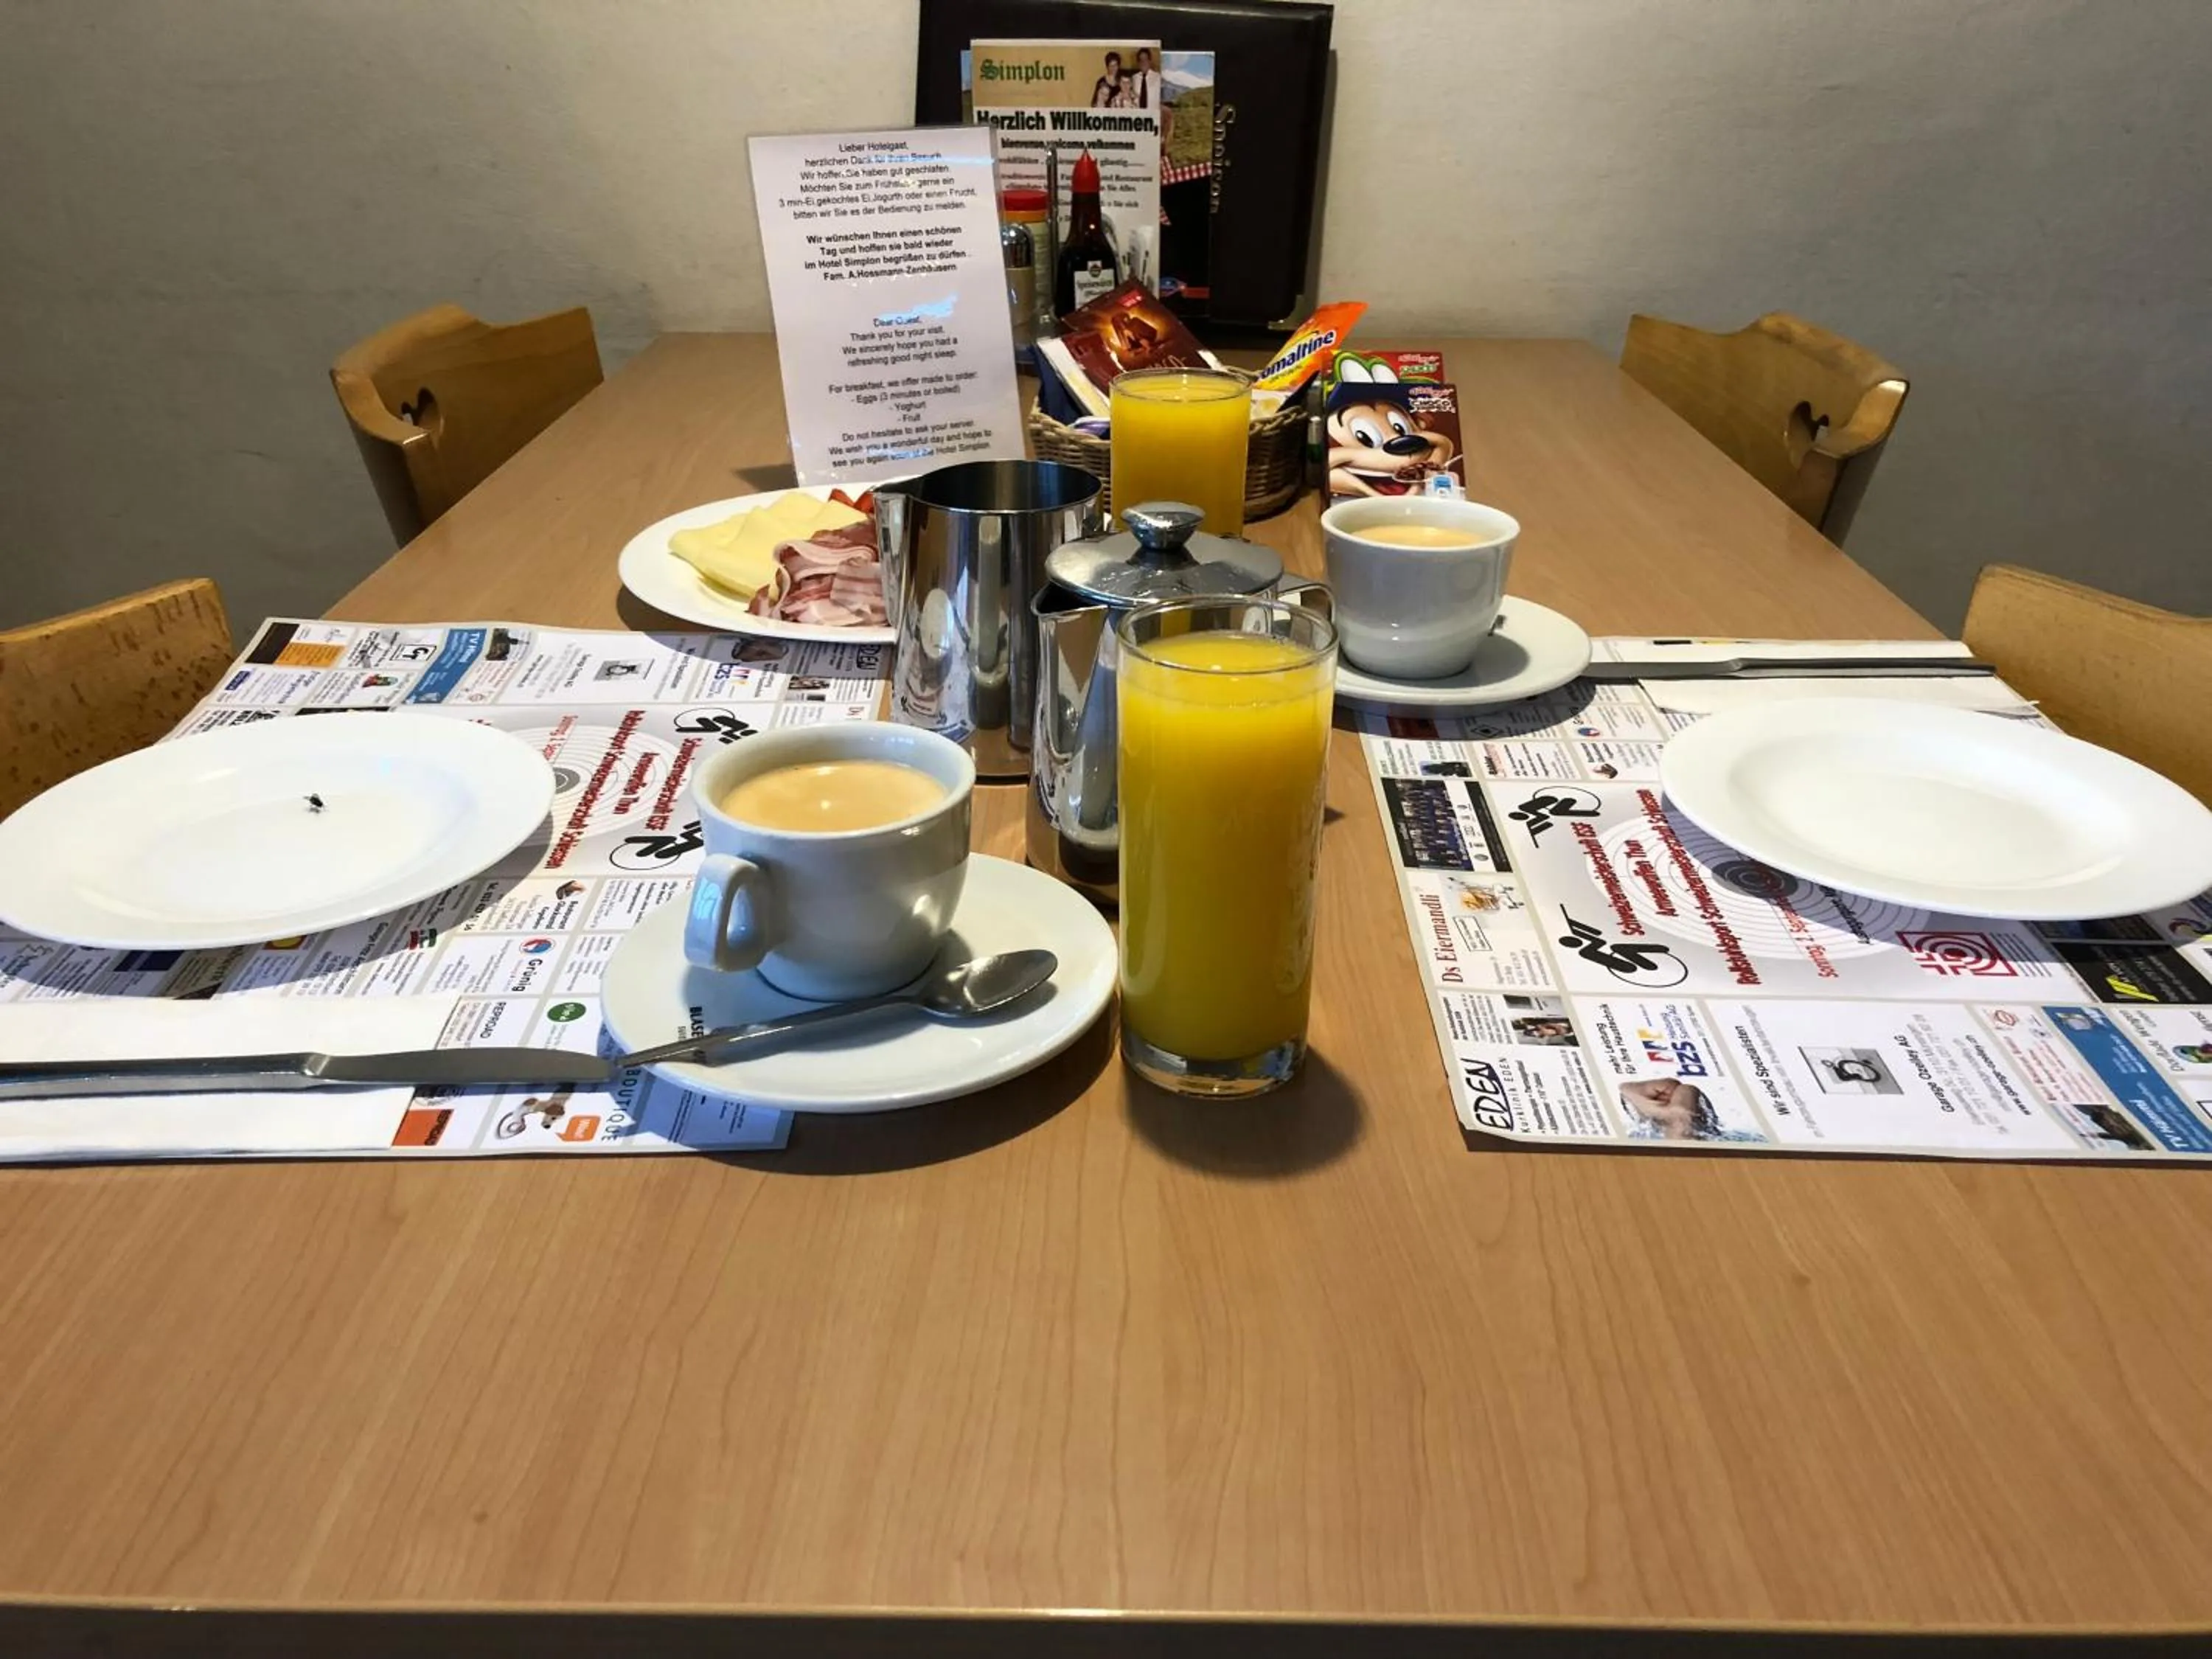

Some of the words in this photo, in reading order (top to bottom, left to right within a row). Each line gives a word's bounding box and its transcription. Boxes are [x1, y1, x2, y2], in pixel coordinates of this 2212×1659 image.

[980, 59, 1065, 82] Simplon
[977, 111, 1046, 131] Herzlich
[1050, 111, 1158, 136] Willkommen,
[838, 142, 866, 153] Lieber
[804, 156, 849, 167] herzlichen
[800, 172, 815, 181] Wir
[862, 167, 888, 177] haben
[889, 167, 902, 177] gut
[799, 183, 837, 193] Möchten
[838, 182, 852, 191] Sie
[942, 176, 955, 185] ein
[905, 191, 922, 201] oder
[793, 210, 817, 220] bitten
[819, 209, 832, 218] wir
[861, 206, 876, 215] der
[877, 204, 922, 216] Bedienung
[806, 235, 822, 244] Wir
[825, 232, 871, 243] wünschen
[872, 230, 897, 240] Ihnen
[899, 229, 923, 237] einen
[925, 226, 961, 236] schönen
[820, 247, 837, 257] Tag
[838, 246, 857, 254] und
[858, 243, 886, 253] hoffen
[888, 242, 902, 251] sie
[903, 241, 922, 250] bald
[925, 239, 953, 248] wieder
[818, 259, 842, 268] Hotel
[844, 256, 880, 268] Simplon
[850, 331, 875, 341] Thank
[877, 332, 893, 341] you
[894, 329, 905, 338] for
[908, 329, 924, 338] your
[842, 346, 857, 355] We
[858, 342, 894, 355] sincerely
[896, 340, 917, 351] hope
[918, 340, 933, 349] you
[935, 337, 950, 346] had
[1259, 330, 1335, 378] omaltine
[847, 355, 888, 369] refreshing
[890, 353, 911, 364] good
[912, 351, 933, 362] night
[828, 384, 843, 393] For
[901, 376, 919, 386] offer
[922, 374, 943, 384] made
[945, 373, 953, 381] to
[856, 393, 877, 405] Eggs
[889, 389, 922, 400] minutes
[894, 400, 926, 413] Yoghurt
[842, 433, 854, 442] Do
[856, 431, 869, 440] not
[871, 427, 903, 439] hesitate
[905, 426, 913, 434] to
[914, 425, 929, 434] ask
[931, 424, 947, 434] your
[829, 446, 843, 455] We
[844, 444, 862, 453] wish
[889, 437, 928, 448] wonderful
[930, 434, 944, 445] day
[946, 433, 961, 442] and
[962, 431, 982, 442] hope
[849, 457, 865, 467] you
[1636, 790, 1668, 824] Schiessen
[1571, 822, 1596, 838] ISSF
[1624, 840, 1646, 858] Thun
[1651, 826, 1724, 919] Schweizermeisterschaft
[1579, 839, 1645, 936] Schweizermeisterschaft
[1633, 860, 1679, 917] Armeewaffen
[1419, 894, 1457, 961] Eiermandli
[1705, 921, 1761, 984] Rollstuhlsport
[512, 959, 543, 991] Grünig
[1441, 967, 1463, 982] Ds
[689, 1006, 704, 1039] BLASE
[1600, 1004, 1624, 1046] Haustechnik
[1596, 1023, 1615, 1053] Leistung
[1894, 1036, 1911, 1047] AG
[1620, 1048, 1631, 1062] Ihre
[1672, 1041, 1708, 1077] bzs
[1735, 1026, 1769, 1077] Spezialisten
[1498, 1057, 1514, 1081] EDEN
[1610, 1055, 1623, 1074] mehr
[1459, 1057, 1516, 1131] EDEN
[1760, 1079, 1781, 1099] sind
[1927, 1082, 1955, 1112] Garage
[601, 1071, 641, 1141] BOUTIQUE
[1509, 1088, 1531, 1133] Kurklinik
[1774, 1101, 1790, 1115] Wir
[2162, 1133, 2190, 1147] TV
